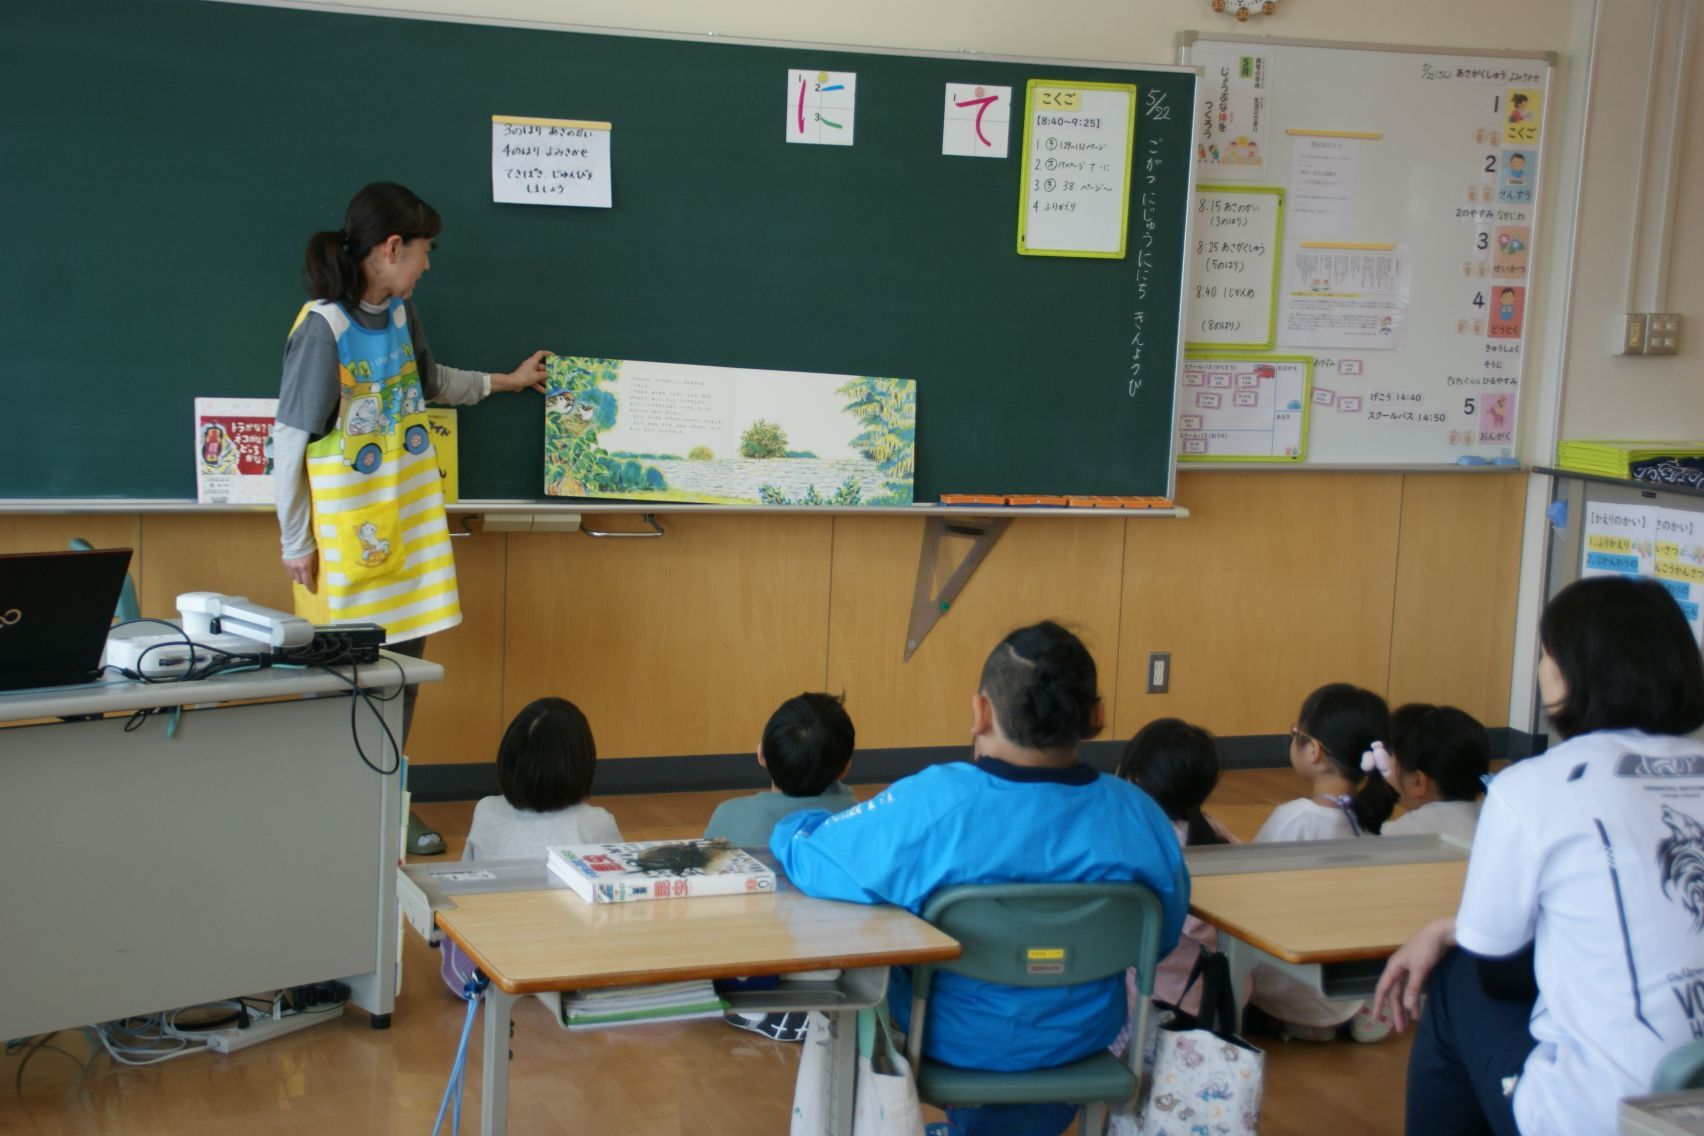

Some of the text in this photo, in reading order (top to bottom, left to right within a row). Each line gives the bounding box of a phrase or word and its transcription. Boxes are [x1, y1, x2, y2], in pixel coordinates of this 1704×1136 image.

[1456, 68, 1507, 80] あさがくしゅう
[1042, 92, 1076, 105] こくご
[1145, 89, 1171, 120] 5/22
[1494, 95, 1499, 113] 1
[1203, 101, 1213, 139] つくろう
[503, 122, 542, 136] 3のはり
[1508, 127, 1537, 139] こくご
[502, 143, 540, 157] 4のはり
[1484, 155, 1497, 173] 2
[526, 184, 564, 194] しましょう
[1476, 232, 1489, 250] 3
[1128, 137, 1163, 398] ごがつ にじゅうににち きんようび
[1472, 291, 1485, 309] 4
[1485, 344, 1520, 353] きゅうしょく
[1483, 361, 1503, 369] そうじ
[1482, 376, 1518, 385] ひるやすみ
[1370, 392, 1422, 402] げこう 14:40
[1463, 397, 1475, 415] 5
[1367, 411, 1446, 422] スクールバス 14:50
[1479, 432, 1511, 442] おんがく
[1590, 512, 1646, 528] 【かえりのかい】
